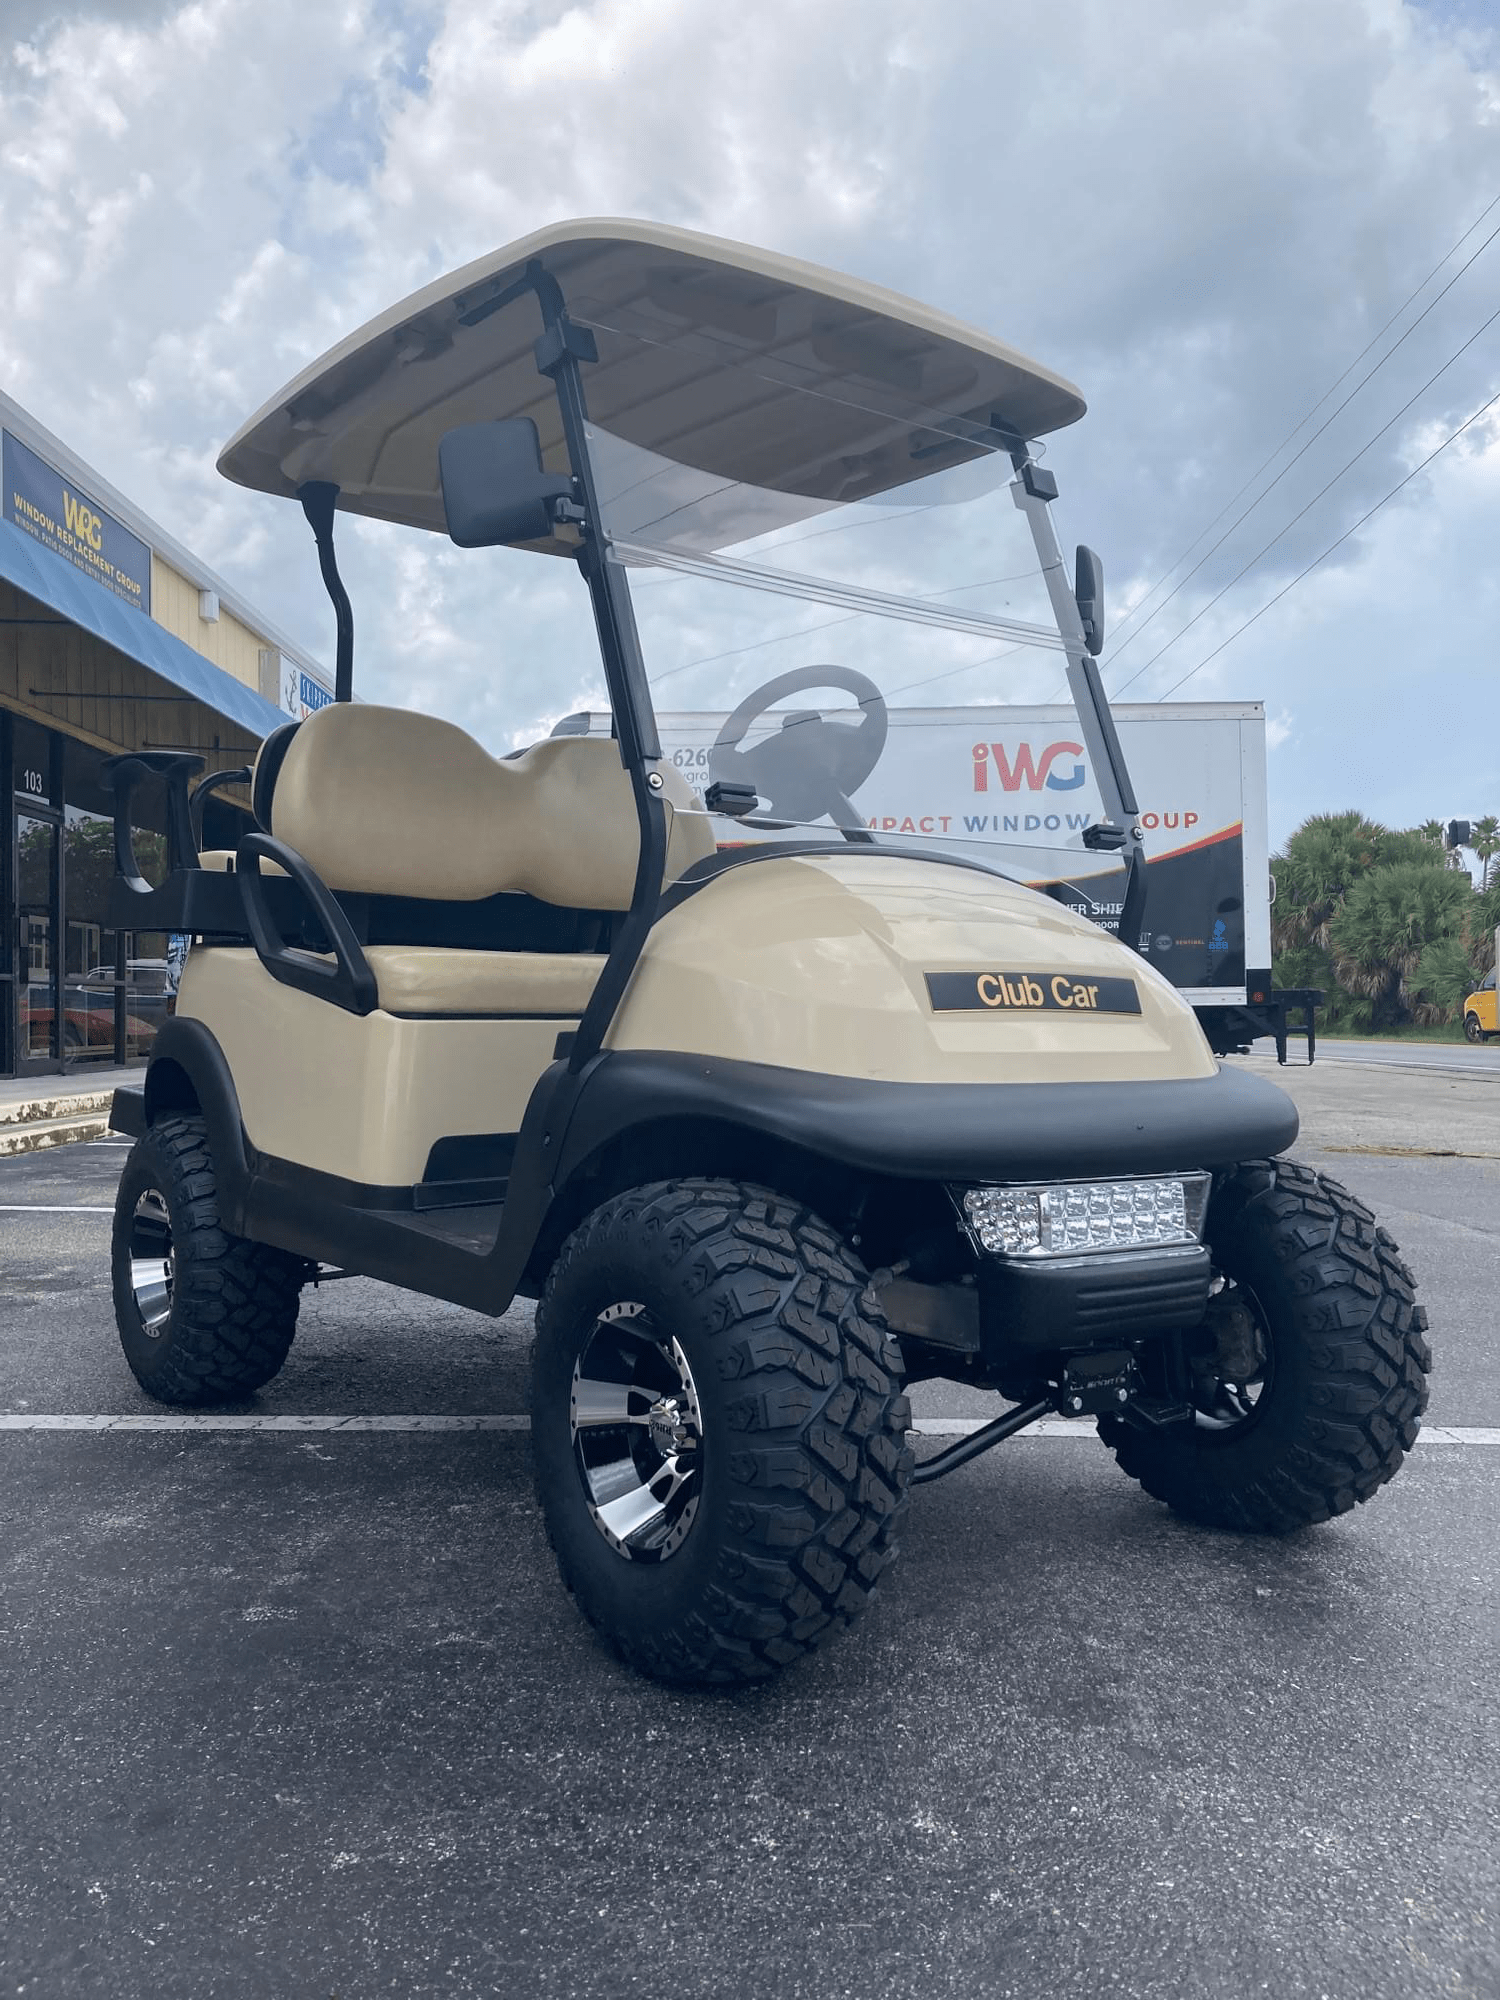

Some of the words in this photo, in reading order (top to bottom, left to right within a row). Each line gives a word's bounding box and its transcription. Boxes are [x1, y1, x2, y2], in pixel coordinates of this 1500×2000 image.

[63, 489, 102, 551] WRG
[13, 491, 54, 533] WINDOW
[57, 525, 114, 577] REPLACEMENT
[116, 570, 141, 595] GROUP
[24, 769, 42, 794] 103
[865, 816, 952, 833] MPACT
[963, 813, 1091, 833] WINDOW
[1102, 812, 1199, 830] OUP
[1091, 902, 1124, 915] SHIE
[976, 974, 1044, 1007] Club
[1051, 976, 1098, 1008] Car
